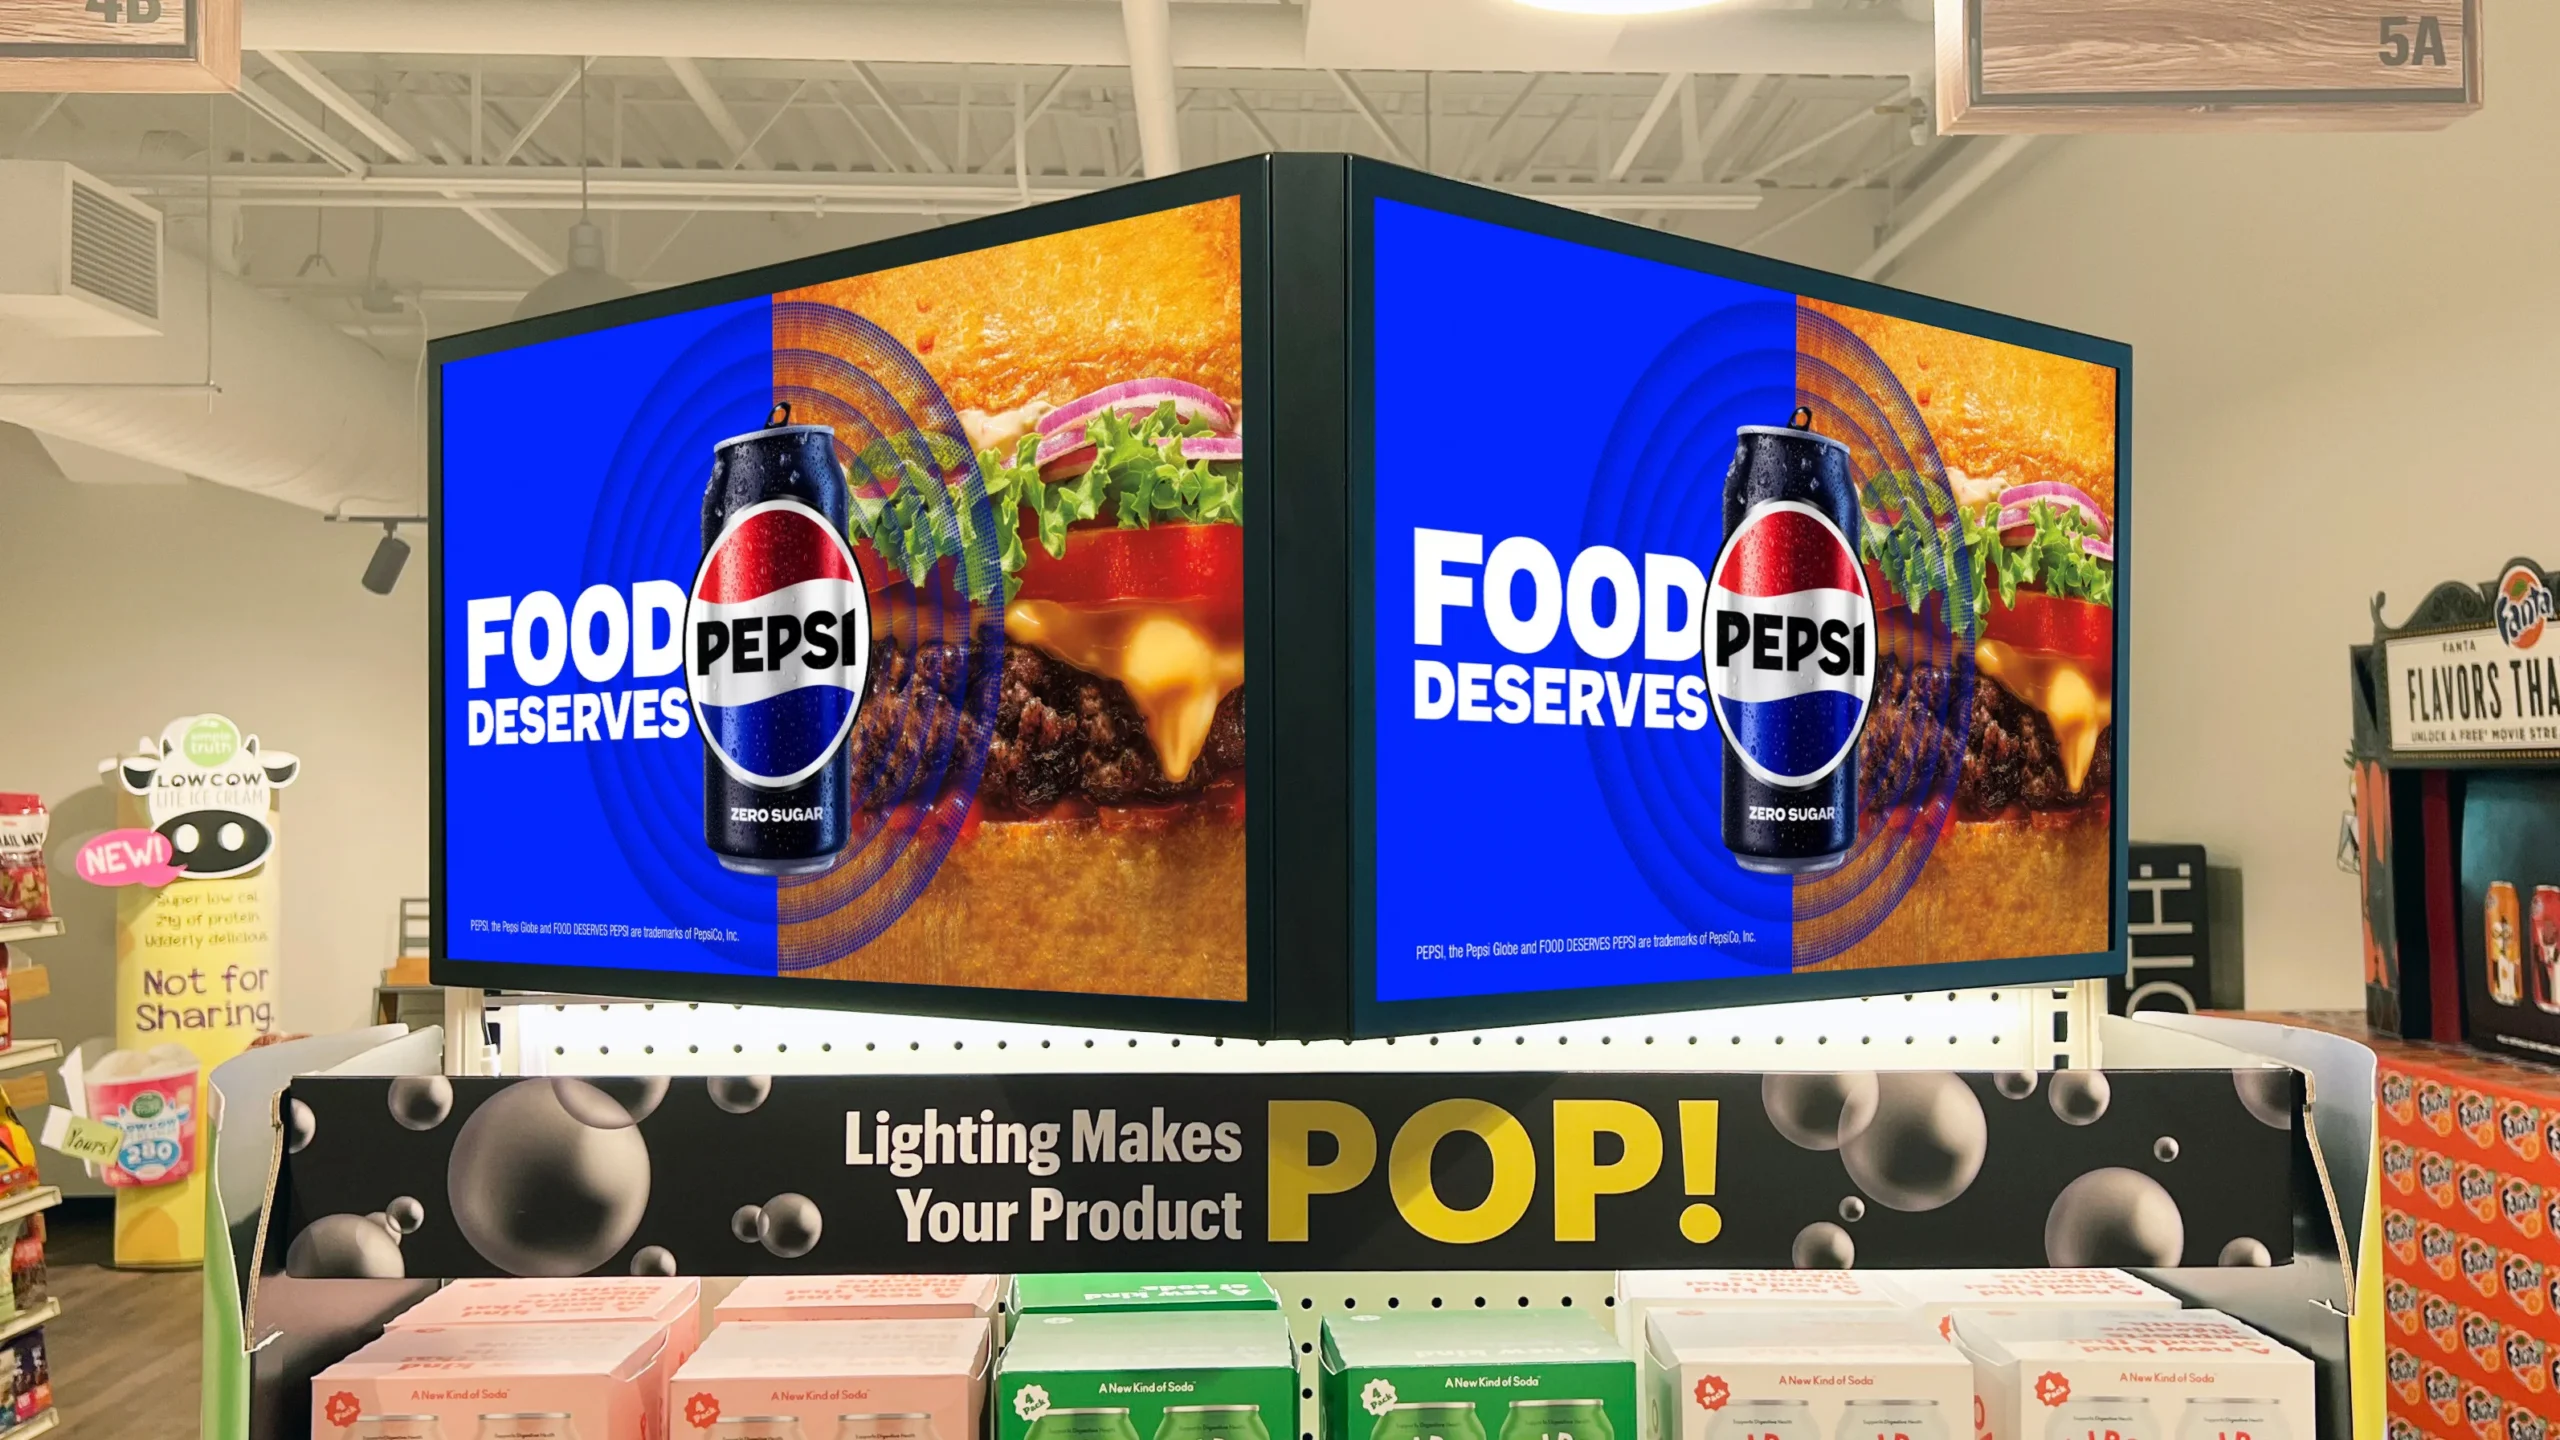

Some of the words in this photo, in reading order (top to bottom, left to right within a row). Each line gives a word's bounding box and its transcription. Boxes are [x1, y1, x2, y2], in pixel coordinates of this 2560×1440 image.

[2378, 15, 2447, 66] 5A
[1414, 526, 1708, 662] FOOD
[2497, 586, 2553, 647] Fanta
[467, 579, 688, 689] FOOD
[696, 607, 857, 676] PEPSI
[1716, 609, 1865, 677] PEPSI
[2443, 640, 2476, 654] FANTA
[1414, 659, 1708, 731] DESERVES
[2407, 661, 2503, 722] FLAVORS
[2509, 657, 2560, 718] THA
[467, 686, 690, 747] DESERVES
[2412, 730, 2446, 742] UNLOCK
[2492, 728, 2525, 741] MOVIE
[2529, 726, 2560, 740] STRE
[191, 740, 231, 755] truth
[158, 773, 206, 788] LOW
[211, 773, 262, 787] COW
[730, 807, 769, 822] ZERO
[771, 806, 824, 822] SUGAR
[1749, 806, 1786, 821] ZERO
[1788, 806, 1835, 821] SUGAR
[84, 836, 164, 876] NEW!
[187, 912, 203, 925] of
[208, 911, 260, 927] protein
[470, 920, 490, 932] PEPSI,
[491, 920, 501, 932] the
[502, 920, 519, 935] Pepsi
[520, 921, 538, 934] Globe
[540, 922, 551, 934] and
[553, 922, 572, 935] FOOD
[573, 923, 608, 937] DESERVES
[609, 925, 629, 937] PEPSI
[630, 927, 642, 938] are
[643, 926, 683, 940] trademarks
[685, 927, 693, 940] of
[693, 927, 725, 944] PepsiCo,
[726, 929, 740, 942] Inc.
[1416, 944, 1447, 961] PEPSI,
[1448, 945, 1464, 958] the
[1466, 943, 1490, 959] Pepsi
[1493, 942, 1518, 956] Globe
[1521, 941, 1537, 955] and
[1539, 940, 1564, 954] FOOD
[1566, 936, 1611, 952] DESERVES
[1612, 936, 1636, 949] PEPSI
[1638, 937, 1651, 948] are
[1653, 933, 1698, 947] trademarks
[1699, 932, 1708, 945] of
[1709, 931, 1741, 945] PepsiCo,
[1742, 930, 1756, 943] Inc.
[143, 967, 207, 996] Not
[221, 964, 269, 993] for
[66, 1127, 119, 1157] Yours!
[845, 1108, 1060, 1177] Lighting
[1071, 1107, 1242, 1164] Makes
[1267, 1098, 1722, 1244] POP!
[896, 1186, 1018, 1243] Your
[1039, 1187, 1242, 1243] Product
[1084, 1292, 1149, 1300] kind
[1445, 1378, 1454, 1388] A
[1456, 1378, 1477, 1388] New
[1478, 1377, 1501, 1388] Kind
[1502, 1376, 1512, 1387] of
[1779, 1375, 1787, 1385] A
[1789, 1375, 1812, 1385] New
[1814, 1375, 1836, 1385] Kind
[1837, 1375, 1847, 1385] of
[2120, 1373, 2128, 1382] A
[2130, 1373, 2153, 1383] New
[2154, 1373, 2176, 1383] Kind
[2178, 1373, 2187, 1383] of
[411, 1391, 420, 1400] A
[421, 1390, 444, 1400] New
[446, 1389, 468, 1399] Kind
[469, 1390, 480, 1399] of
[771, 1391, 779, 1401] A
[781, 1391, 804, 1400] New
[806, 1390, 828, 1400] Kind
[829, 1390, 840, 1400] of
[1099, 1383, 1108, 1393] A
[1109, 1383, 1132, 1393] New
[1133, 1383, 1155, 1393] Kind
[1156, 1382, 1167, 1393] of
[1372, 1387, 1381, 1398] 4
[2043, 1384, 2066, 1402] Pack
[1025, 1393, 1035, 1404] 4
[1370, 1393, 1392, 1410] Pack
[1703, 1388, 1726, 1405] Pack
[1022, 1398, 1046, 1415] Pack
